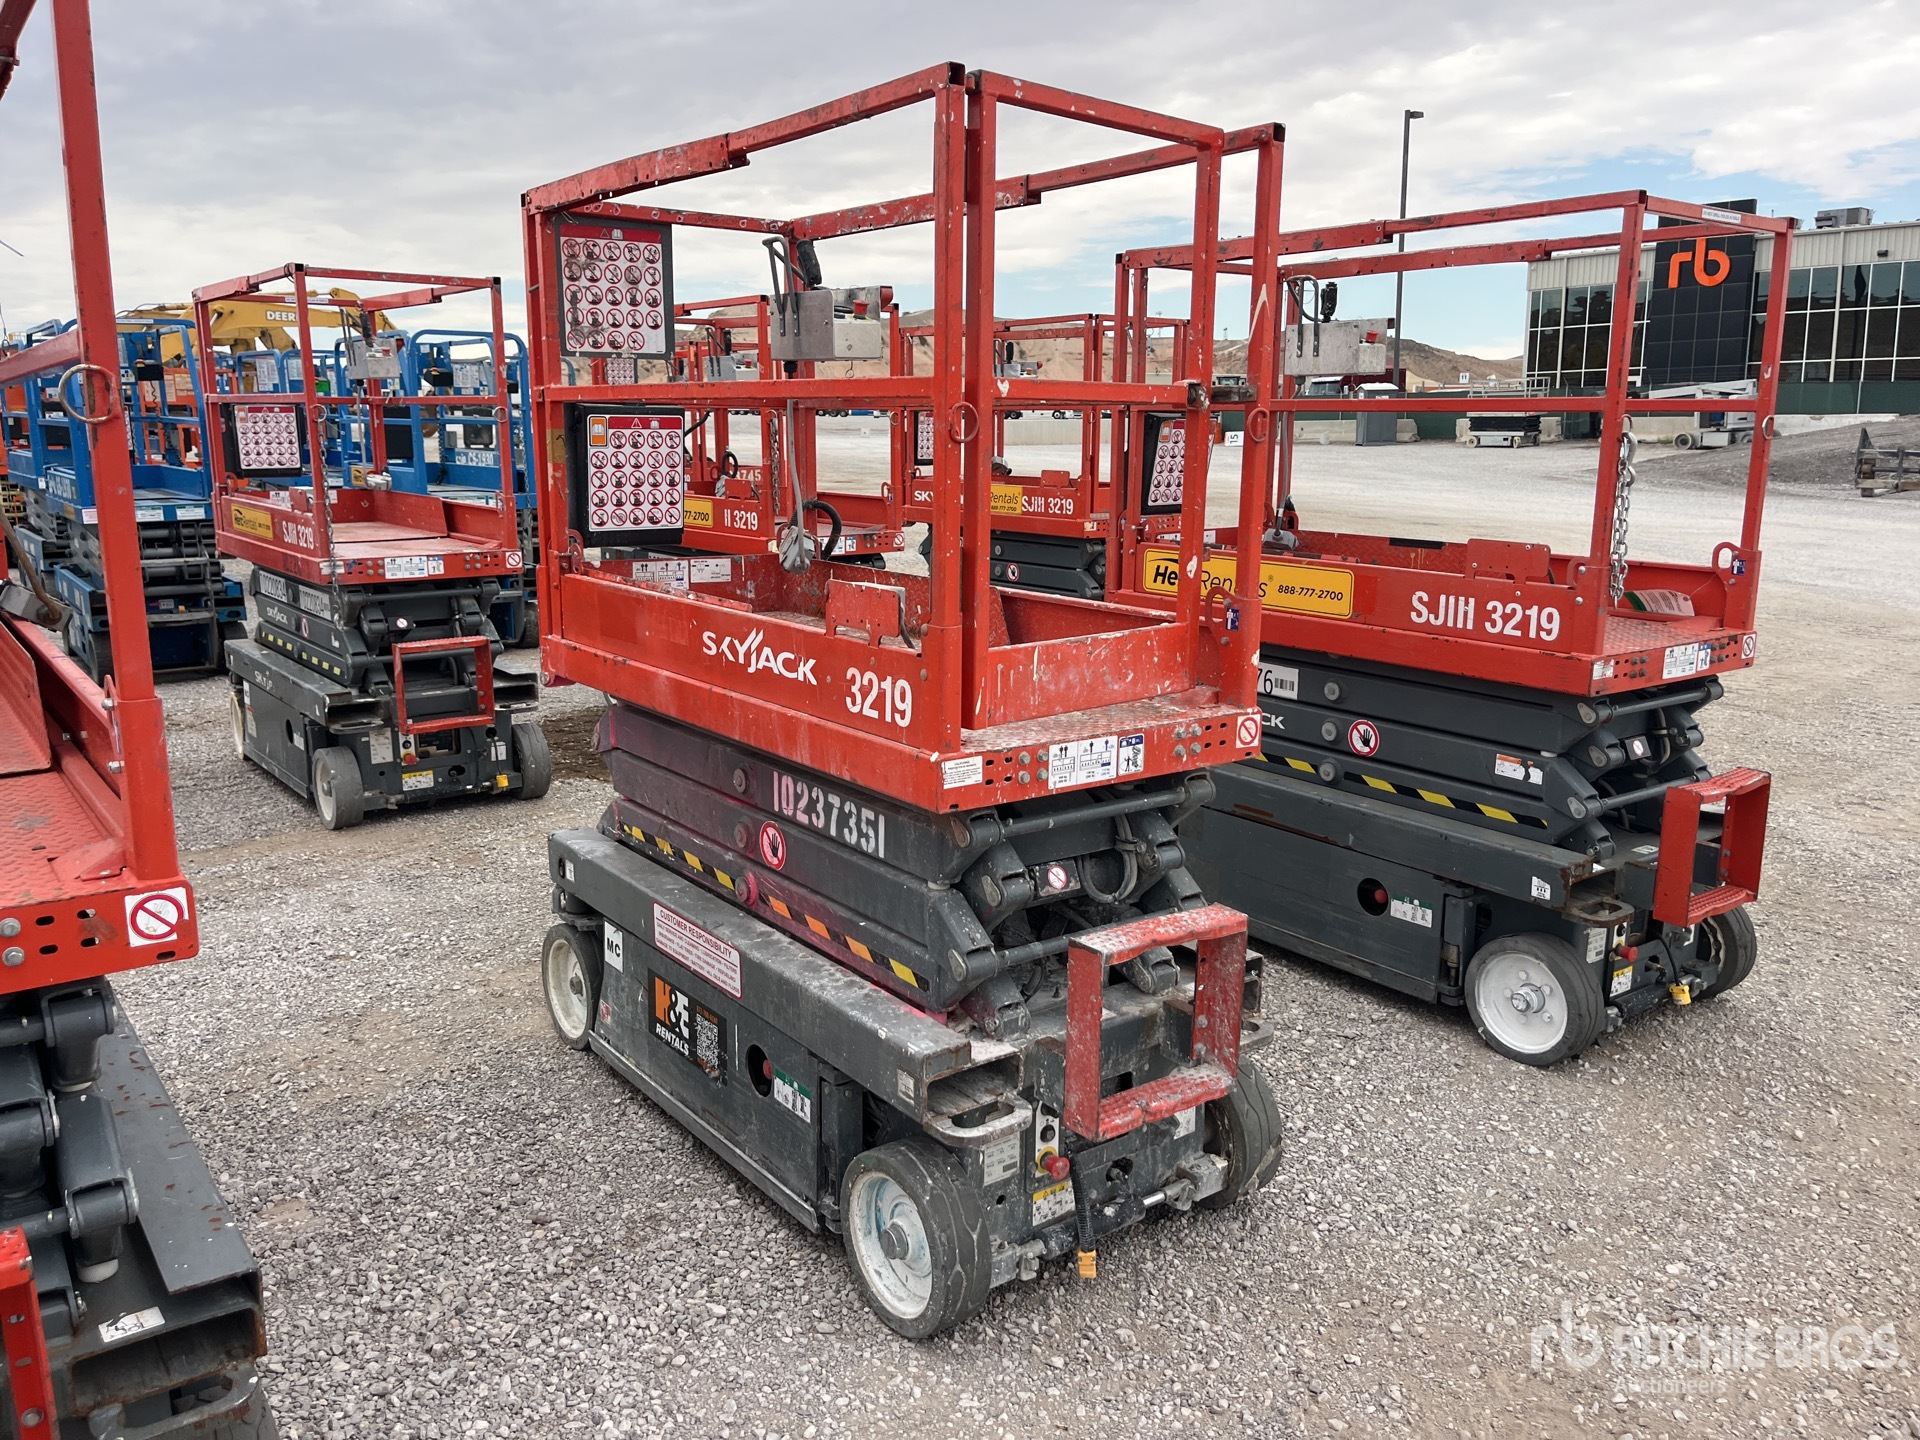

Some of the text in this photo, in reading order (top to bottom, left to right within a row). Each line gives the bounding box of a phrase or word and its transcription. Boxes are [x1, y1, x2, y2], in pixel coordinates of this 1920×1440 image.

[1668, 238, 1730, 288] rb
[266, 311, 298, 322] DEER
[684, 510, 709, 521] 77-2700
[1048, 497, 1074, 515] 3219
[733, 510, 758, 531] 3219
[298, 524, 314, 550] 3219
[1277, 584, 1344, 602] 888-777-2700
[1484, 600, 1560, 641] 3219
[702, 626, 913, 728] SKYJACK 3219
[773, 770, 885, 859] 10237351
[660, 909, 731, 959] CUSTOMER RESPONSIBILITY
[606, 937, 621, 958] MC
[655, 1022, 689, 1057] RENTALS
